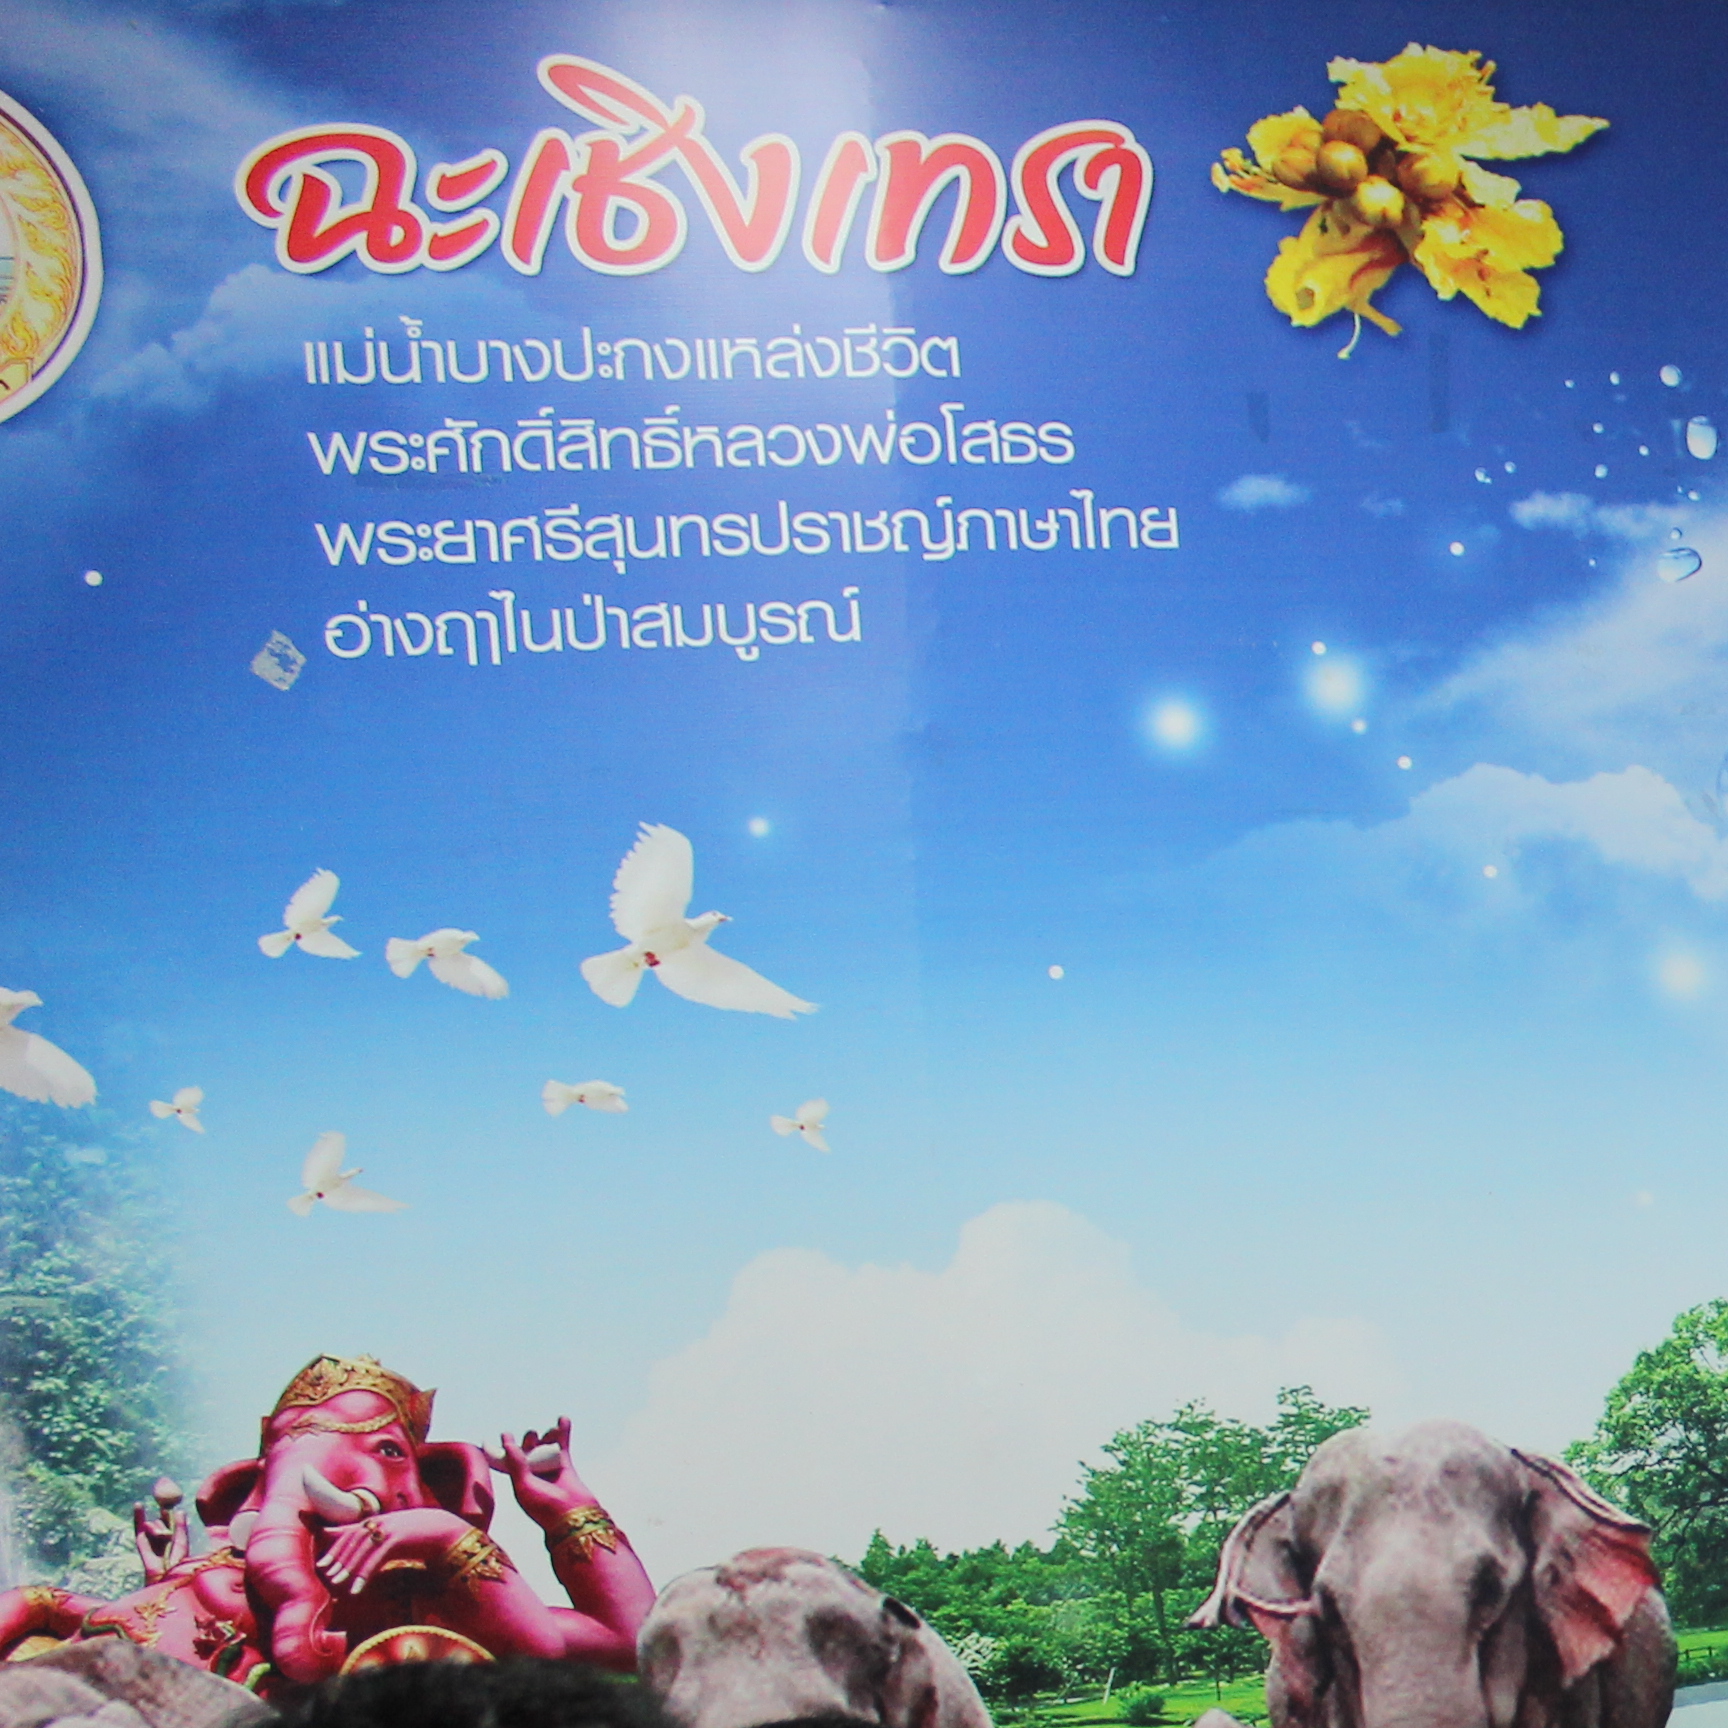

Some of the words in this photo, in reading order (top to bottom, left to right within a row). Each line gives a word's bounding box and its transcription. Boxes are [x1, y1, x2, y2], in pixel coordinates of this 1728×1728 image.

[235, 53, 1153, 277] ฉะเชิงเทรา
[303, 315, 962, 385] แม่น้ำบางปะกงแหล่งชีวิต
[306, 403, 1076, 475] พระศักดิ์สิทธิ์หลวงพ่อโสธร
[314, 489, 1180, 574] พระยาศรีสุนทรปราชญ์ภาษาไทย
